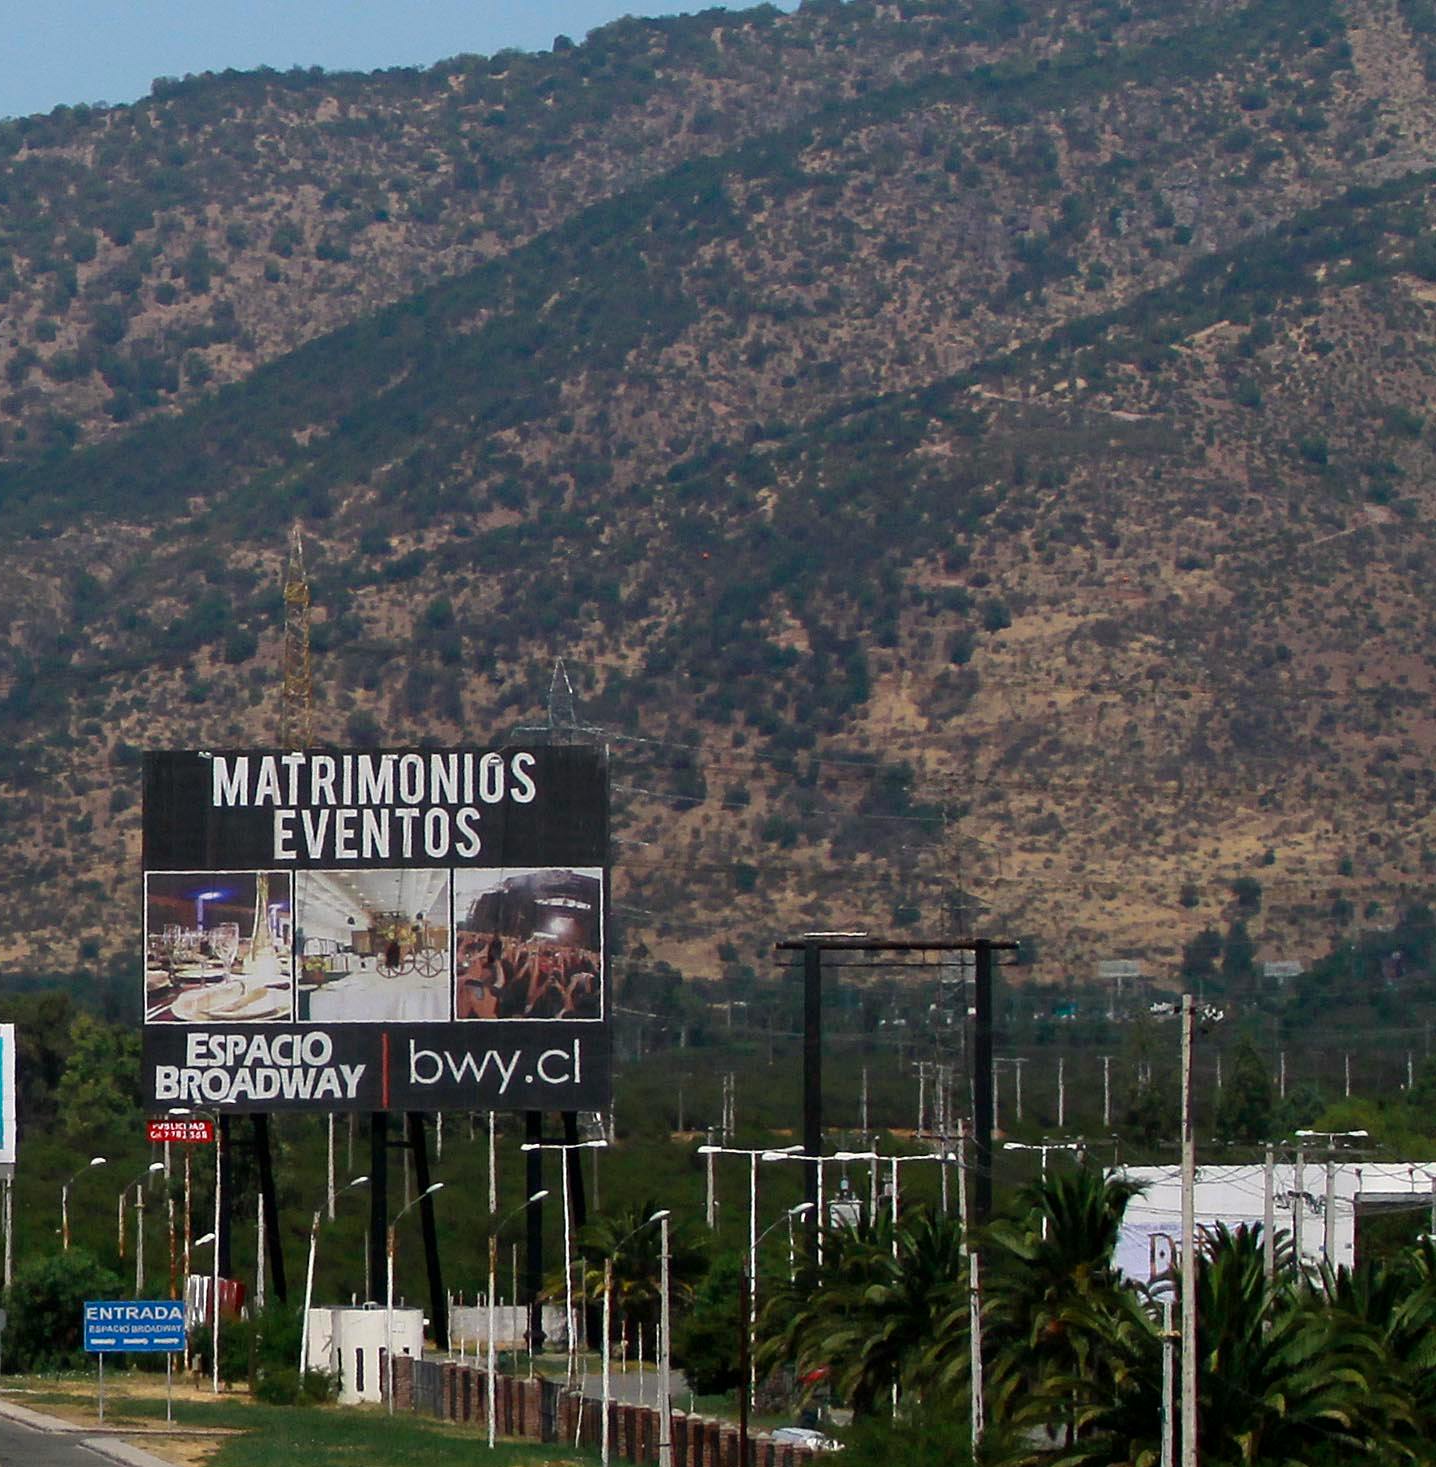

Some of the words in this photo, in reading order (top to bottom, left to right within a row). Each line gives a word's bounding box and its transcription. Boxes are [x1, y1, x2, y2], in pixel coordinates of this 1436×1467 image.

[212, 752, 536, 807] MATRIMONIOS
[273, 807, 482, 860] EVENTOS
[186, 1031, 332, 1068] ESPACIO
[409, 1039, 581, 1093] bwy.cl
[154, 1063, 366, 1101] BROADWAY
[86, 1307, 182, 1320] ENTRADA
[88, 1324, 130, 1333] ESPACIO
[131, 1324, 182, 1333] BROADWAY
